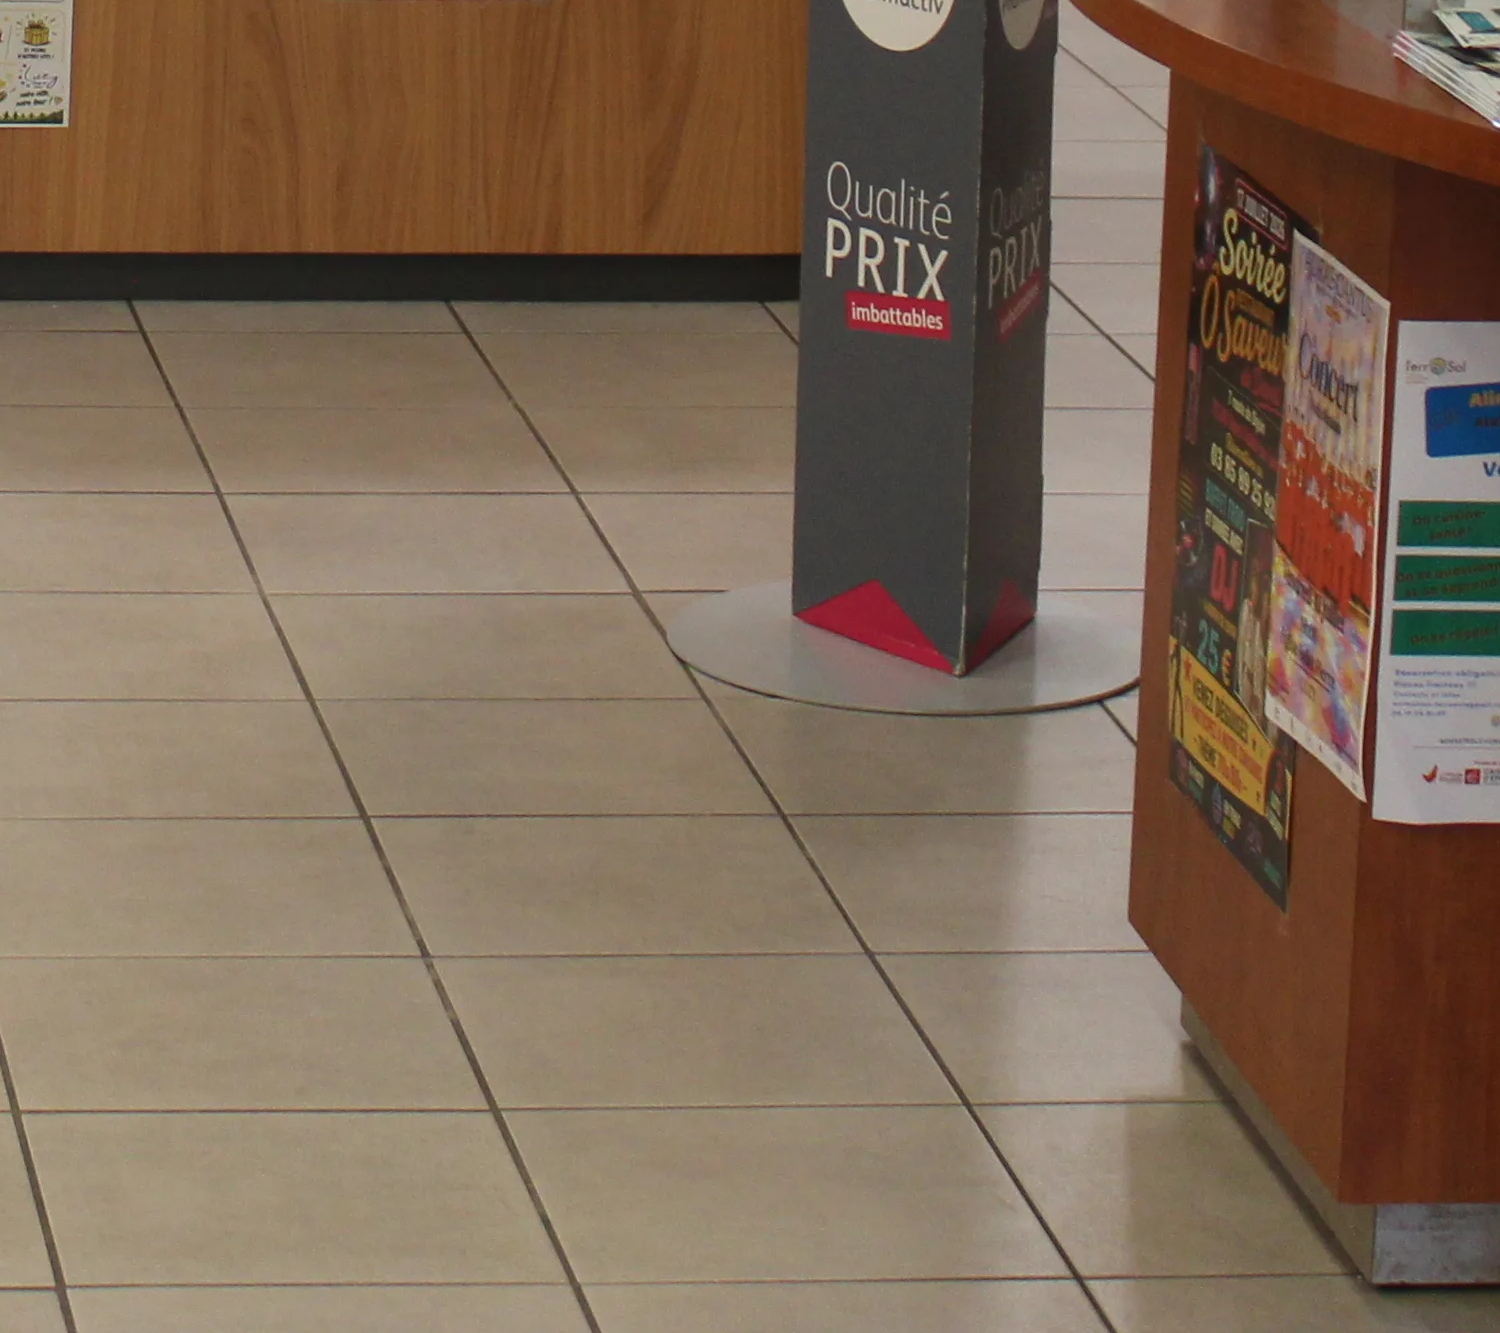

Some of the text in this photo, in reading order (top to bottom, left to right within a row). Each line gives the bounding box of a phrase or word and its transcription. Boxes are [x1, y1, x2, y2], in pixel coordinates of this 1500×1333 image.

[827, 161, 952, 239] Qualité
[825, 218, 949, 302] PRIX
[1219, 208, 1285, 304] Soirée
[851, 301, 944, 331] imbattables
[1210, 543, 1238, 611] DJ
